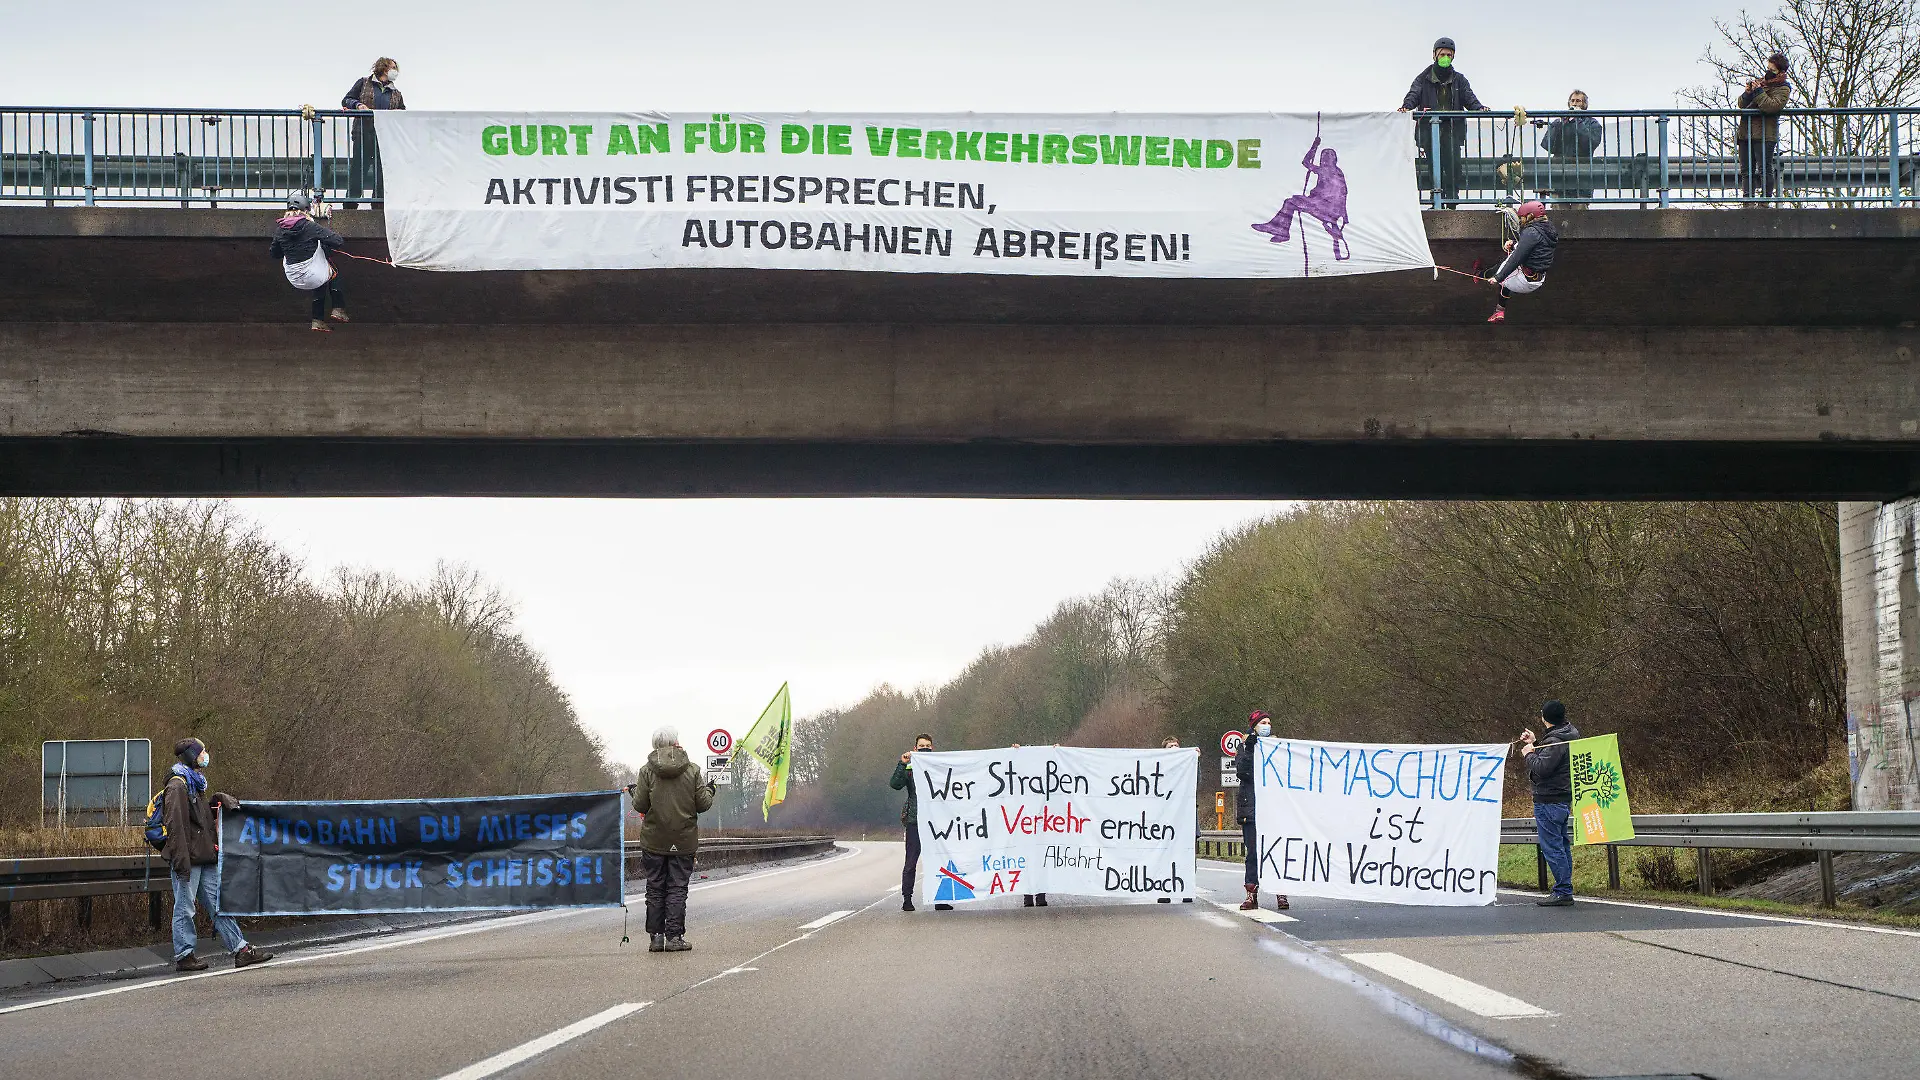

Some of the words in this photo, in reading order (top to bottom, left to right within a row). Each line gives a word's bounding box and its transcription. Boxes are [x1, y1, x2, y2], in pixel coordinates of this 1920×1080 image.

[482, 125, 592, 156] GURT
[607, 123, 670, 155] AN
[684, 114, 766, 153] FÜR
[781, 124, 852, 155] DIE
[866, 127, 1260, 168] VERKEHRSWENDE
[485, 175, 673, 204] AKTIVISTI
[687, 176, 996, 214] FREISPRECHEN,
[682, 220, 952, 256] AUTOBAHNEN
[973, 228, 1189, 269] ABREIßEN!
[712, 735, 726, 747] 60
[924, 768, 975, 800] Wer
[989, 761, 1088, 801] Straßen
[1108, 761, 1172, 800] säht,
[1257, 738, 1504, 803] KLIMASCHUTZ
[1572, 754, 1582, 801] ASPHALT
[1579, 753, 1587, 782] STATT
[1585, 751, 1593, 782] WALD
[240, 817, 396, 845] AUTOBAHN
[420, 816, 460, 842] DU
[478, 812, 587, 841] MIESES
[928, 808, 988, 840] wird
[1001, 802, 1091, 835] Verkehr
[1101, 811, 1174, 840] ernten
[1370, 807, 1423, 843] ist
[327, 856, 422, 891] STÜCK
[447, 856, 602, 888] SCHEISSE!
[982, 854, 1026, 871] Keine
[1043, 845, 1105, 871] Abfahrt
[1105, 862, 1184, 892] Döllbach
[1260, 835, 1331, 882] KEIN
[1347, 842, 1496, 895] Verbrecher
